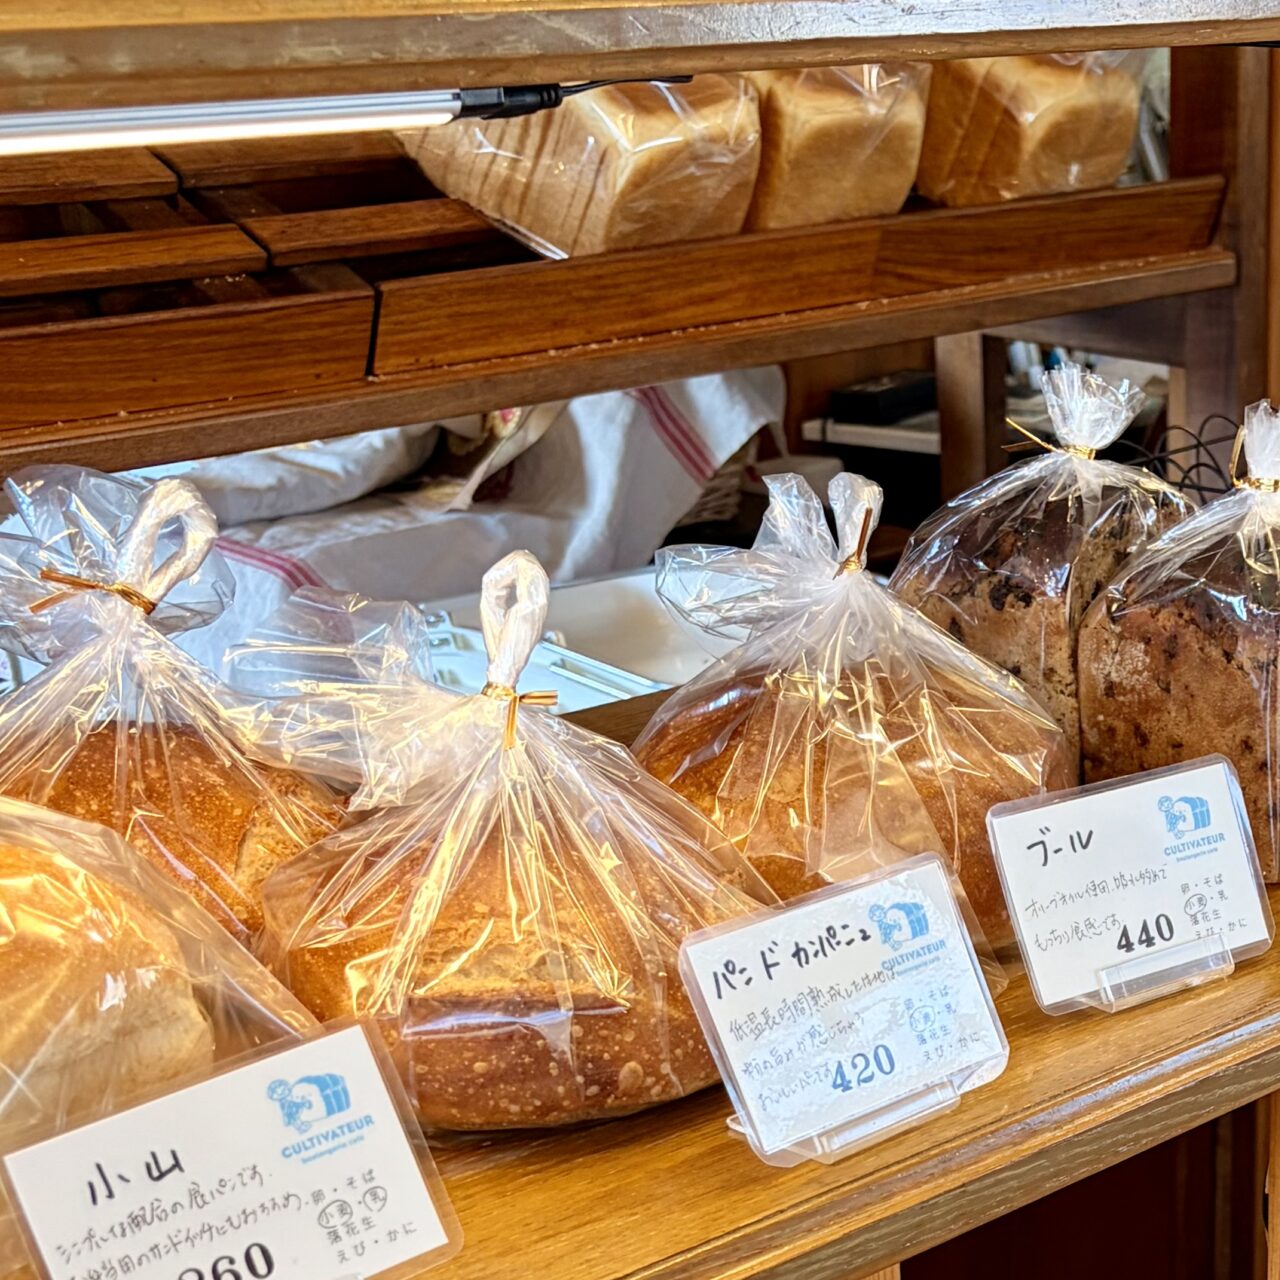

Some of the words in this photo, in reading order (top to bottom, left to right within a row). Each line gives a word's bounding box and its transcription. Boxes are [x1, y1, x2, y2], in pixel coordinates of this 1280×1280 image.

[1026, 826, 1094, 867] ブール
[1163, 832, 1226, 857] CULTIVATEUR
[1117, 913, 1174, 953] 440
[1189, 909, 1222, 926] 落花生
[881, 939, 947, 973] CULTIVATEUR
[825, 1044, 895, 1093] 420
[281, 1115, 374, 1159] CULTIVATEUR
[326, 1216, 376, 1245] 落花生
